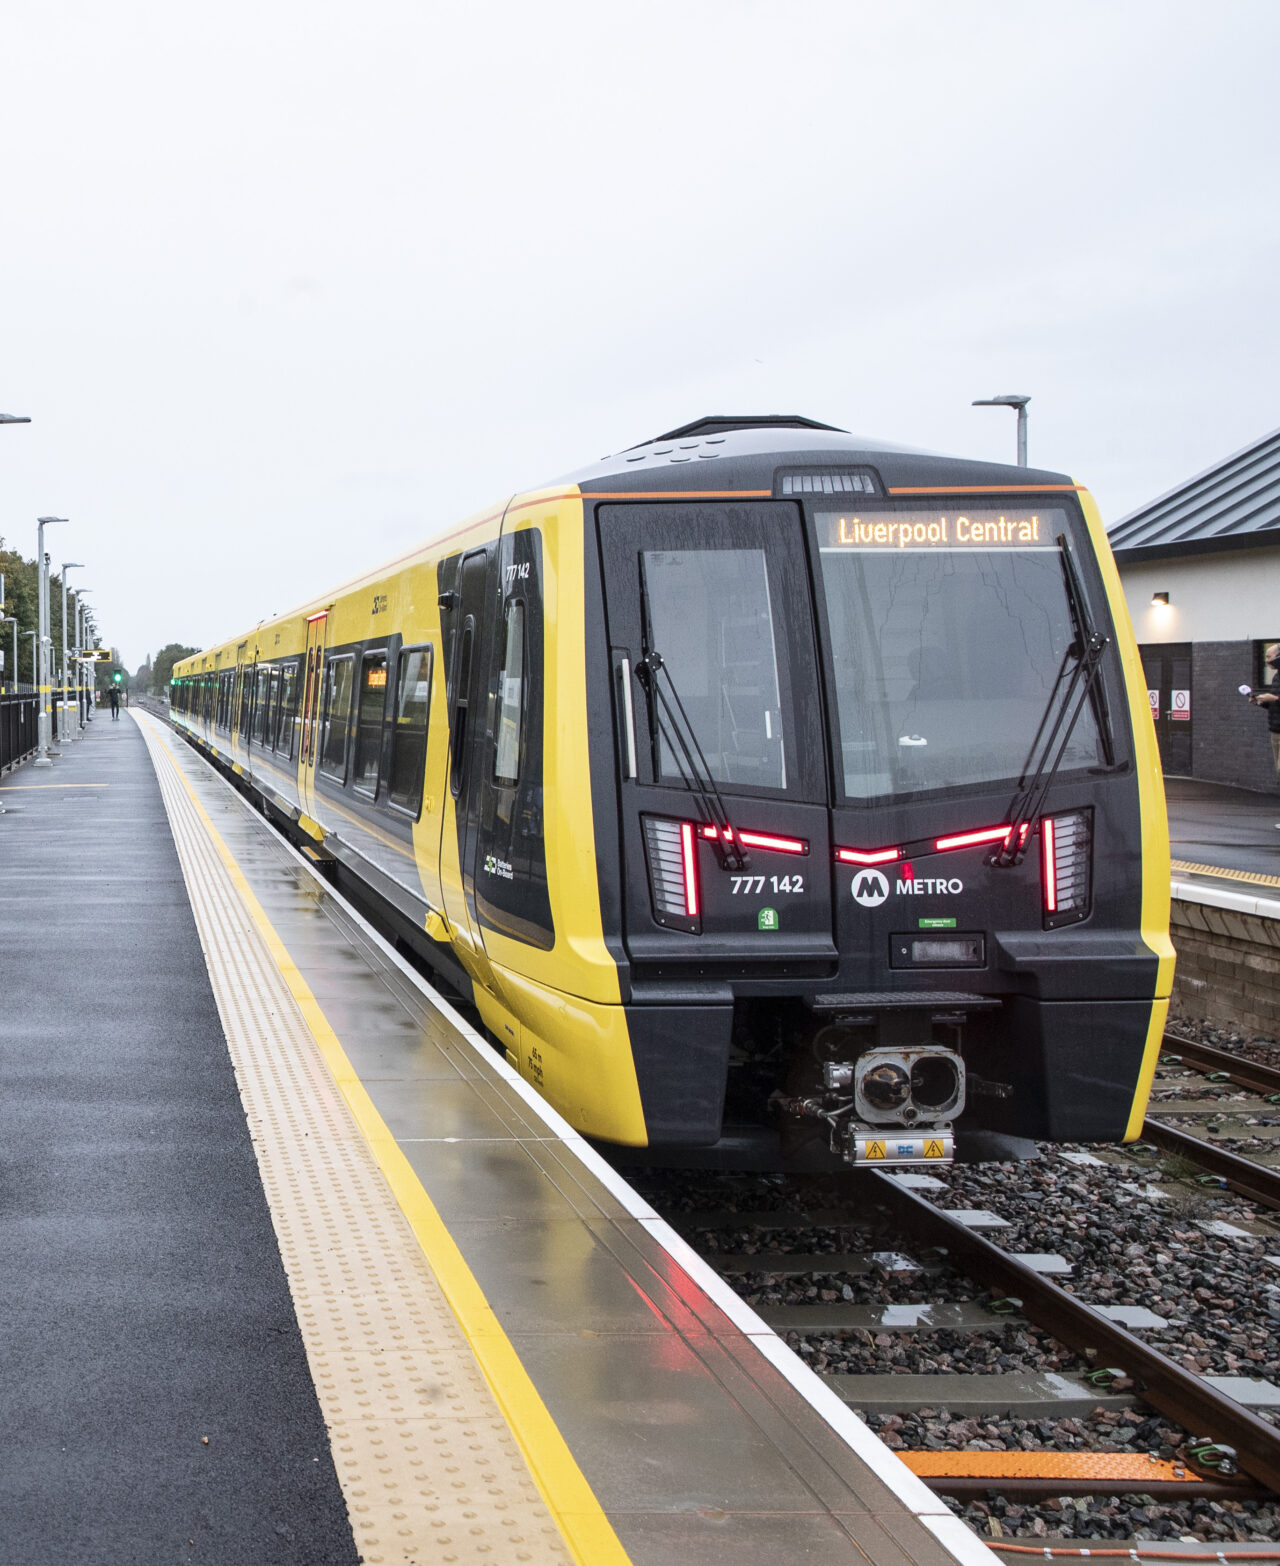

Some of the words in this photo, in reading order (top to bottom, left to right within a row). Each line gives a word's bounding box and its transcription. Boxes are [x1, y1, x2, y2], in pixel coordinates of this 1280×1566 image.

[839, 517, 948, 548] Liverpool
[956, 516, 1040, 542] Central
[506, 564, 517, 581] 777
[517, 562, 530, 579] 142
[730, 875, 766, 894] 777
[770, 875, 804, 893] 142
[896, 878, 964, 895] METRO
